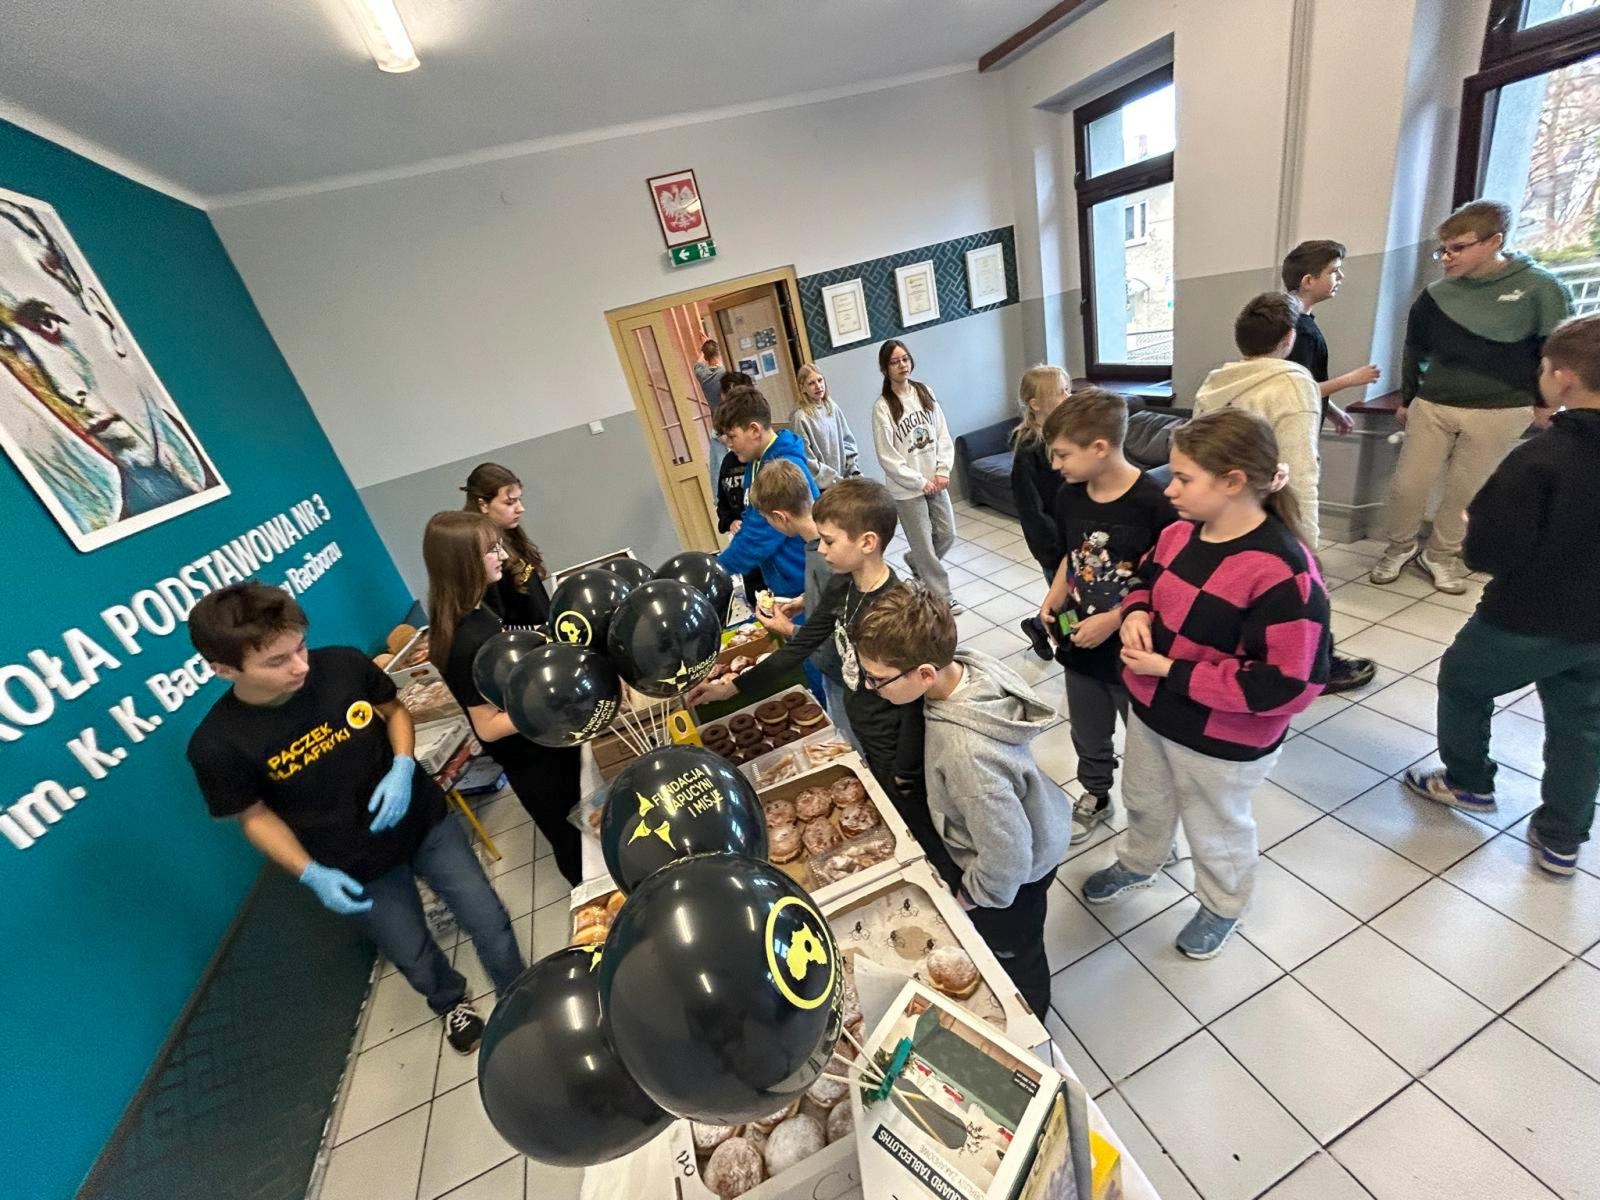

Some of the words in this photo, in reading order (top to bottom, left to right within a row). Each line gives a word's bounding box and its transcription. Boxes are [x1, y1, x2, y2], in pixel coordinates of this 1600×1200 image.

[100, 513, 303, 655] PODSTAWOWA
[290, 499, 323, 535] NR
[312, 493, 331, 520] 3
[0, 780, 86, 850] im.
[66, 727, 128, 779] K.
[109, 696, 163, 743] K.
[285, 541, 343, 594] Raciborzu
[581, 700, 605, 733] FUNDACJA
[303, 727, 351, 766] AFRYKI
[651, 767, 705, 807] FUNDACJA
[687, 806, 697, 818] I
[692, 790, 724, 814] MISJE
[878, 1129, 931, 1182] TABLECLOTHS
